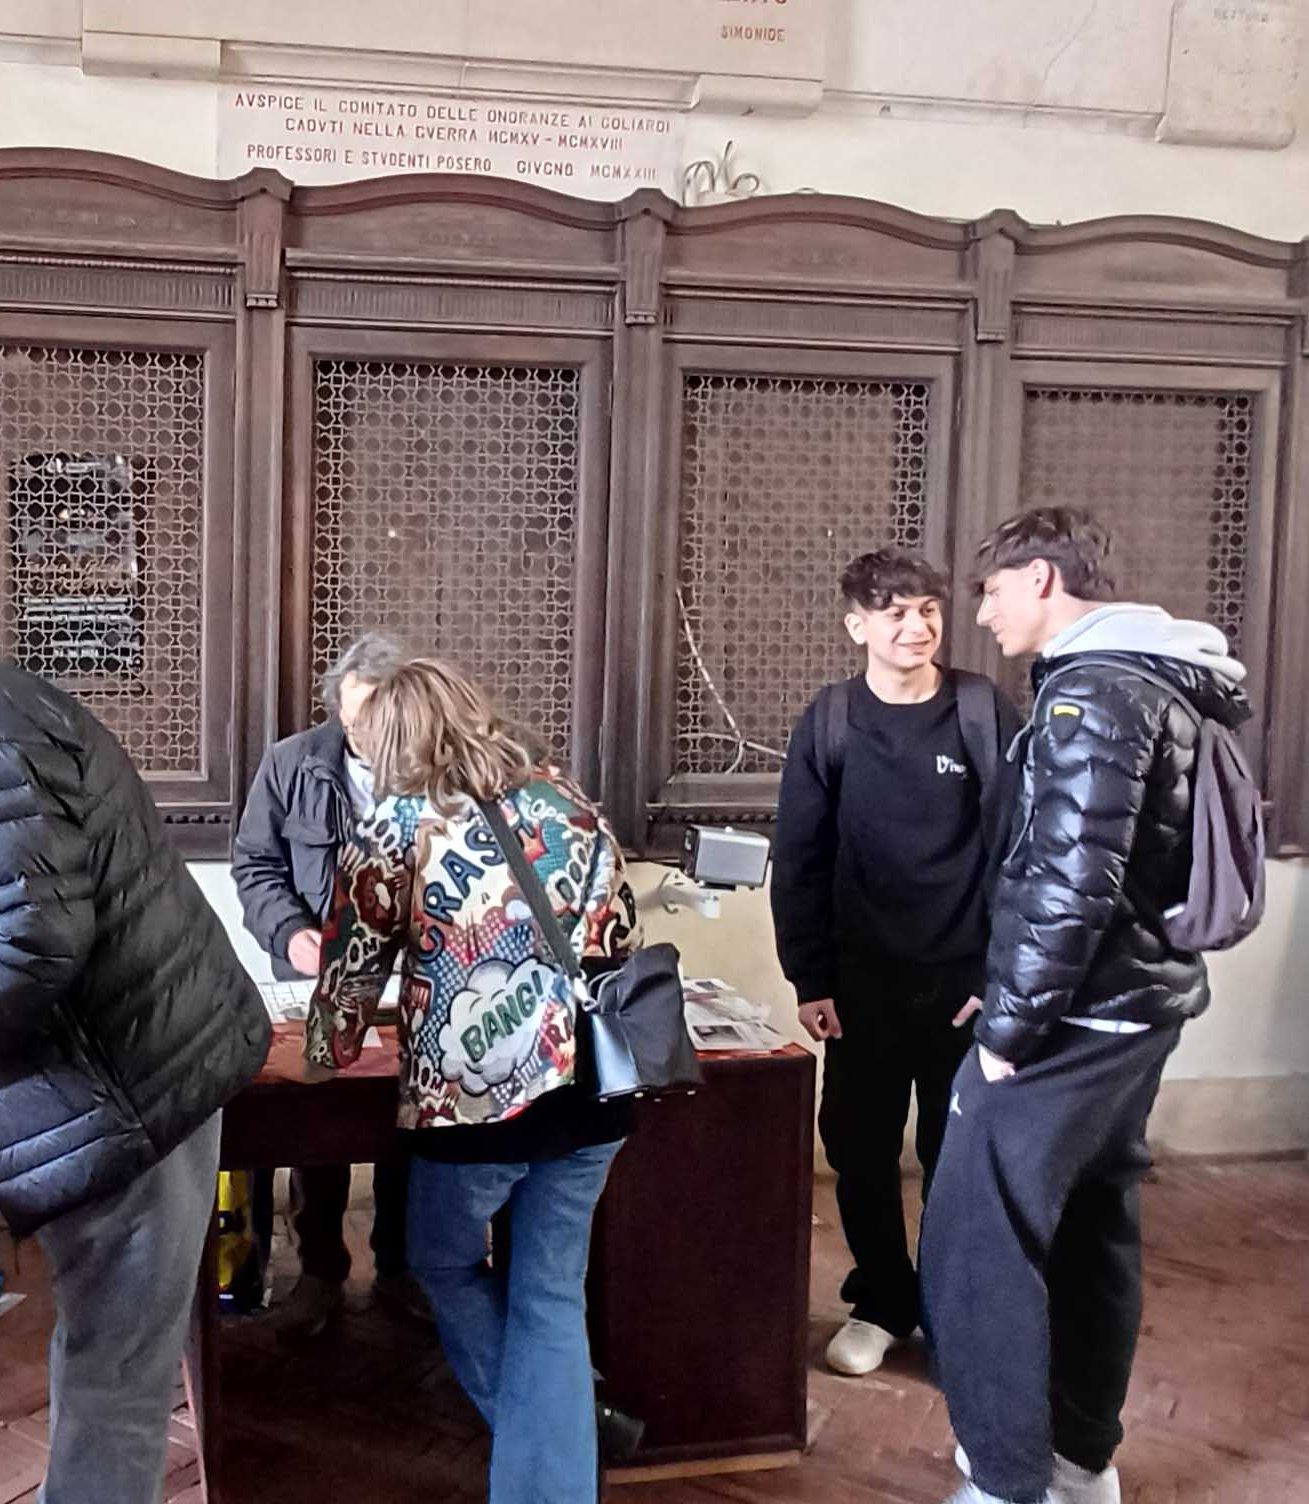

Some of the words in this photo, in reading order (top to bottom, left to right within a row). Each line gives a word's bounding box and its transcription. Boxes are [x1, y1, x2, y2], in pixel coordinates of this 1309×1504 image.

[722, 25, 786, 42] SIMONIDE
[235, 93, 304, 111] AVSPICE
[314, 98, 327, 112] IL
[339, 100, 418, 119] COMITATO
[427, 105, 478, 122] DELLE
[487, 109, 569, 128] ONORANZE
[285, 117, 343, 135] CADVTI
[353, 121, 405, 138] NELLA
[489, 130, 540, 146] MCMXV
[558, 134, 623, 151] MCMXVIII
[247, 143, 337, 163] PROFESSORI
[345, 149, 353, 165] E
[362, 151, 430, 169] STVDENTI
[437, 155, 492, 173] POSERO
[590, 164, 656, 182] MCMXXIII
[418, 825, 507, 964] CRAS
[460, 970, 544, 1063] BANG!
